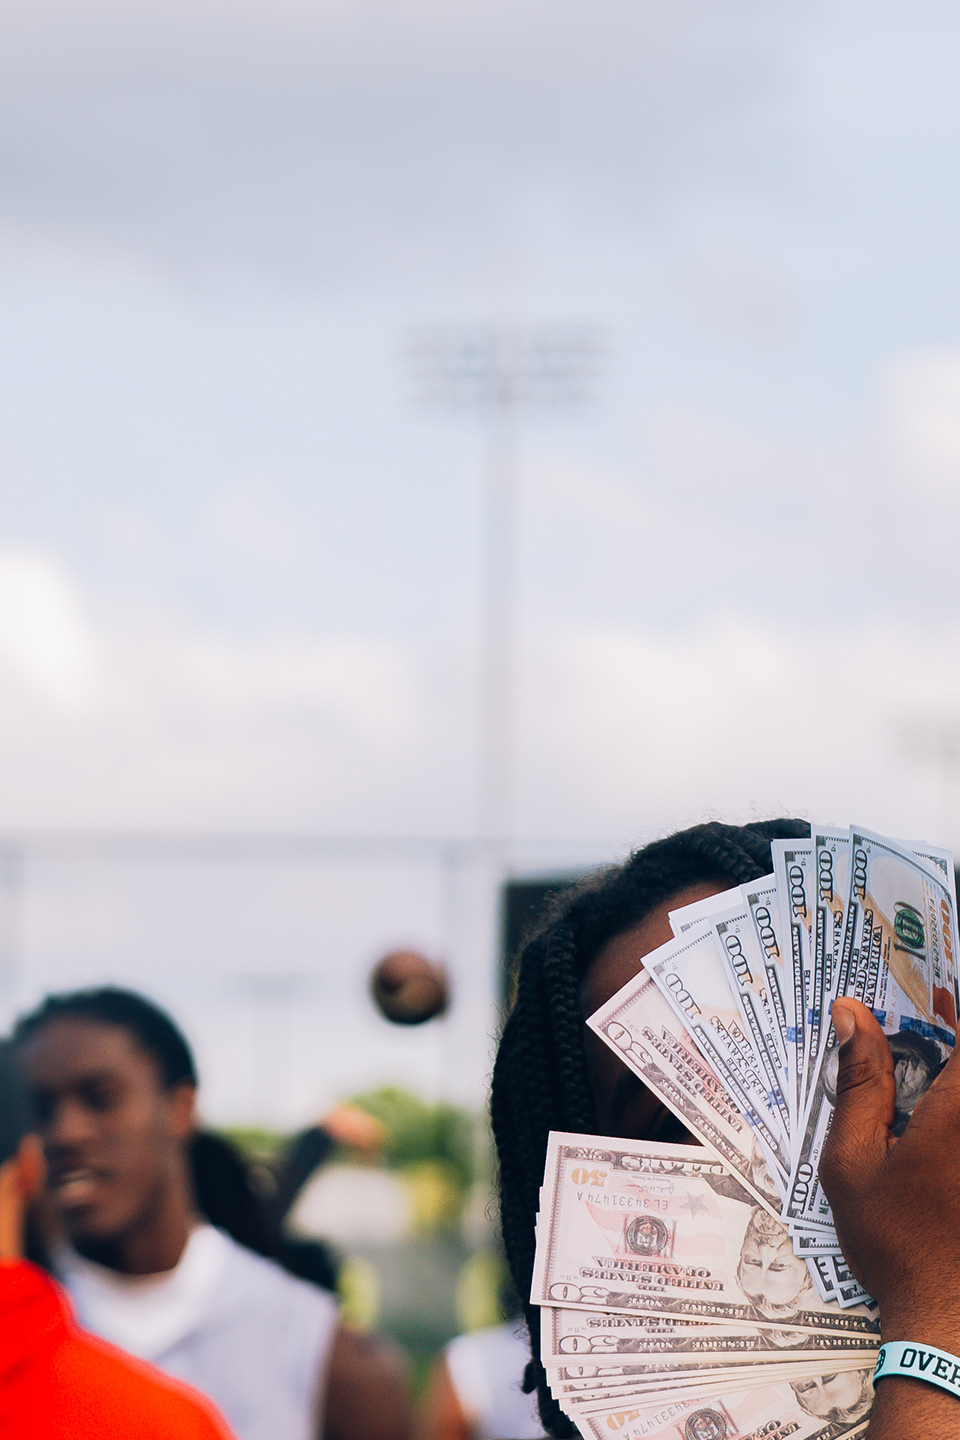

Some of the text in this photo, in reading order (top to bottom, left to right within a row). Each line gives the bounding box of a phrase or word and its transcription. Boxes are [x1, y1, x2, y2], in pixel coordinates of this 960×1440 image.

[790, 866, 807, 918] 100
[818, 850, 834, 902] 100
[854, 849, 868, 900] 100
[755, 906, 780, 960] 100
[843, 904, 856, 962] DOLLARS
[859, 908, 874, 970] STATES
[940, 898, 954, 964] 100
[726, 935, 754, 986] 100
[810, 1031, 819, 1057] ONE
[816, 910, 824, 968] DOLLARS
[824, 954, 832, 992] THE
[849, 948, 860, 986] THE
[866, 926, 882, 997] AMERICA
[665, 973, 702, 1020] 100
[606, 1021, 654, 1068] 50
[662, 1025, 722, 1094] AMERICA
[710, 1016, 750, 1070] STATES
[766, 1033, 782, 1070] THE
[642, 1026, 744, 1134] UNITED STATES
[659, 1079, 686, 1107] NOTE
[676, 1074, 698, 1098] THE
[726, 1058, 750, 1090] THE
[760, 1124, 778, 1150] ONE
[571, 1167, 608, 1188] 50
[576, 1191, 669, 1211] EL 34331474 A
[790, 1162, 814, 1215] 100
[578, 1267, 725, 1292] UNITED STATES
[592, 1256, 712, 1278] OF AMERICA
[638, 1284, 666, 1292] THE
[550, 1282, 866, 1328] FEDERAL RESERVE NOTE 50
[560, 1334, 880, 1354] FEDERAL RESERVE NOTE 50
[758, 1420, 782, 1438] OF
